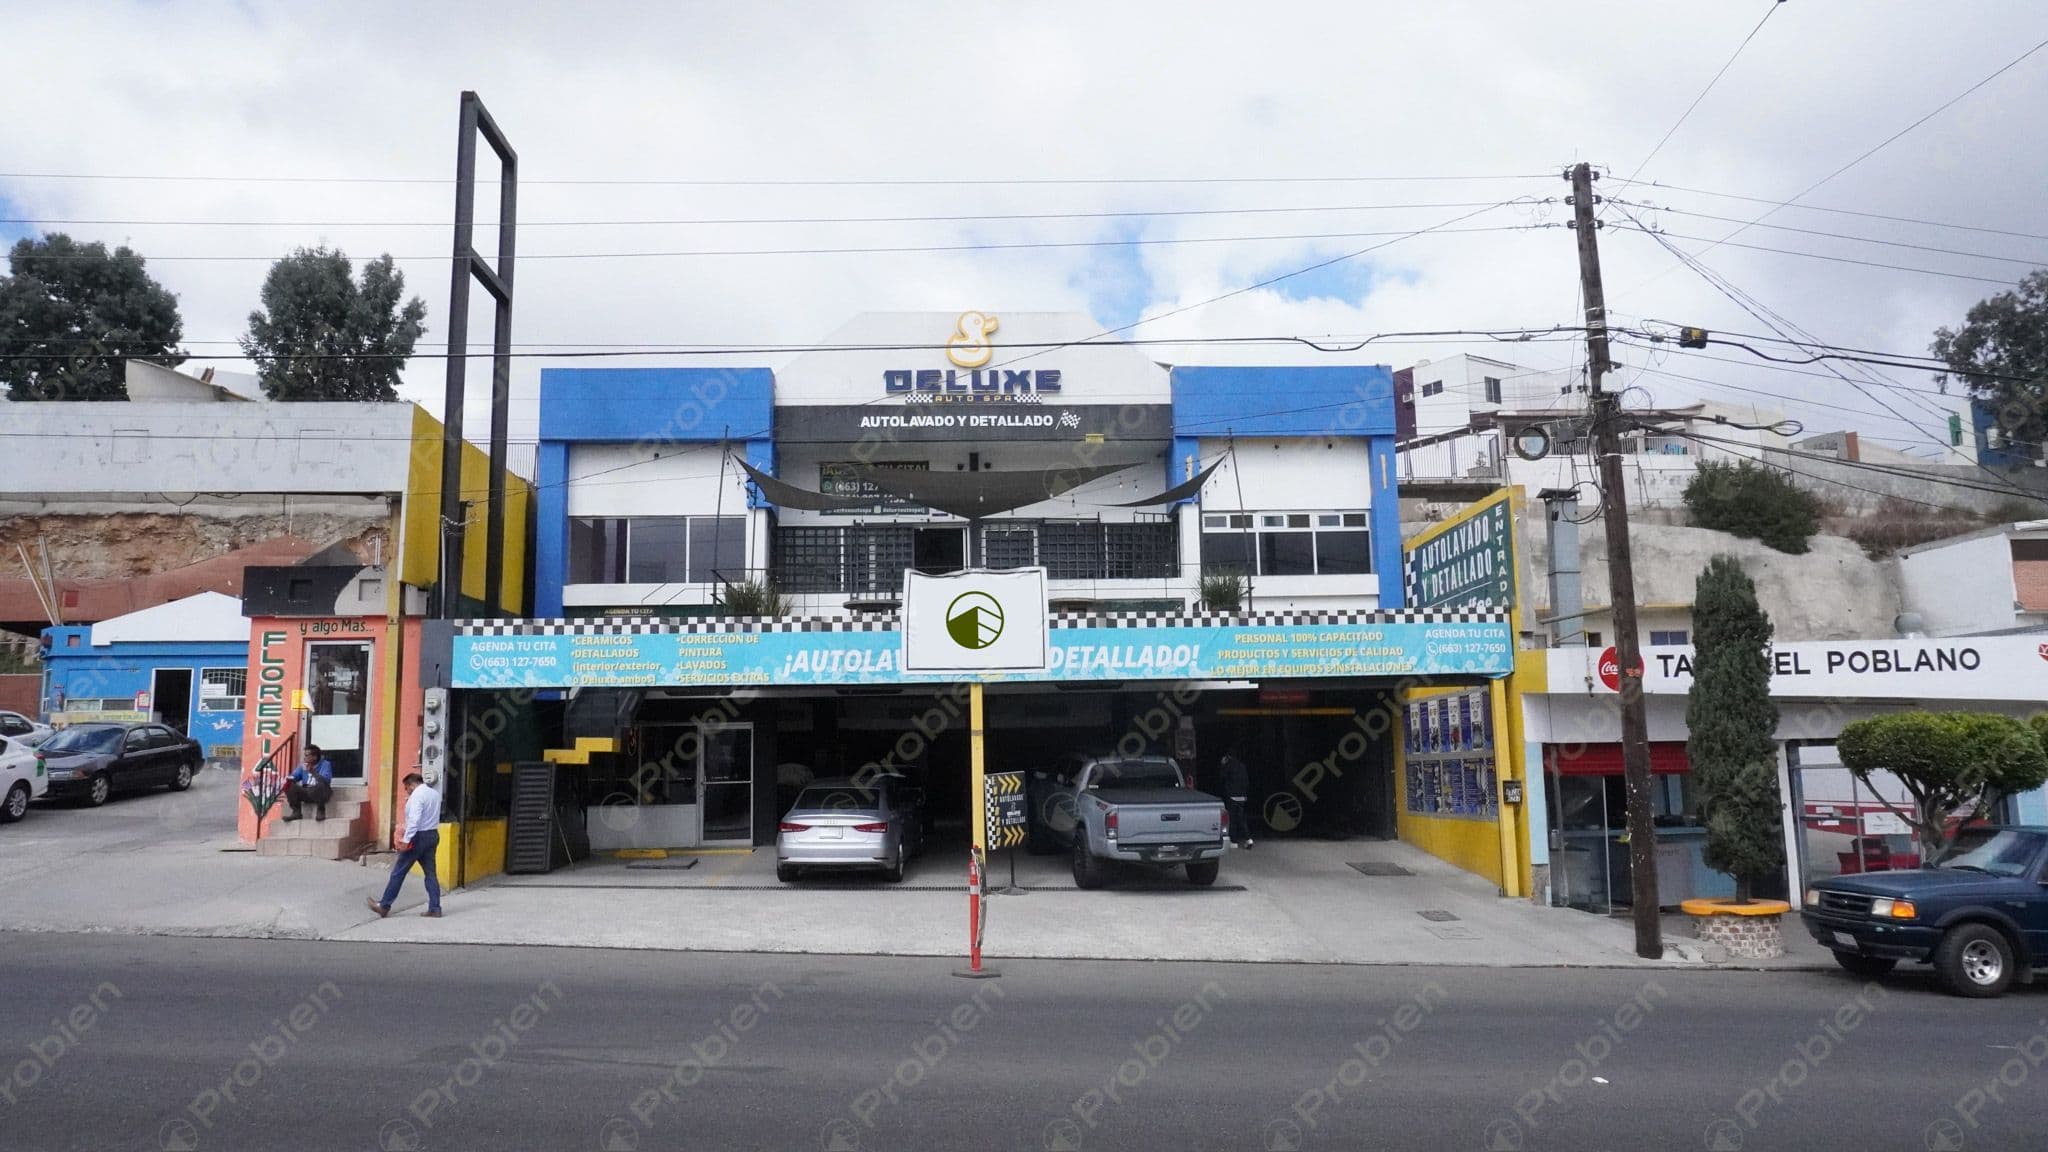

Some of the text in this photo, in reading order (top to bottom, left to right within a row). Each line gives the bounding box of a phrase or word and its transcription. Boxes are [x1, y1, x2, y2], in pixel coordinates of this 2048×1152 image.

[884, 369, 1061, 393] DELUXE
[935, 395, 1013, 403] AUTO SPA
[860, 415, 1053, 428] AUTOLAVADO Y DETALLADO
[1422, 516, 1489, 573] AUTOLAVADO
[1495, 505, 1509, 607] ENTRADA
[1421, 548, 1492, 602] Y DETALLADO
[301, 623, 308, 635] y
[313, 619, 339, 635] algo
[1425, 628, 1506, 639] AGENDA TU CITA
[575, 636, 633, 646] CERAMICOS
[746, 634, 760, 644] DE
[1235, 631, 1385, 644] PERSONAL 100% CAPACITADO
[471, 641, 558, 652] AGENDA TU CITA
[575, 648, 639, 658] DETALLADOS
[679, 647, 723, 657] PINTURA
[1438, 643, 1506, 655] (663) 127-7650
[1049, 644, 1200, 669] DETALLADO!
[1218, 647, 1403, 660] PRODUCTOS Y SERVICIOS DE CALIDAD
[484, 657, 557, 668] (663) 127-7650
[680, 660, 727, 671] LAVADOS
[1827, 648, 1981, 674] POBLANO
[1264, 665, 1277, 675] EN
[1278, 664, 1323, 675] EQUIPOS
[1334, 661, 1413, 674] INSTALACIONES
[680, 672, 770, 684] SERVICIOS EXTRAS
[254, 631, 288, 773] FLORERIA
